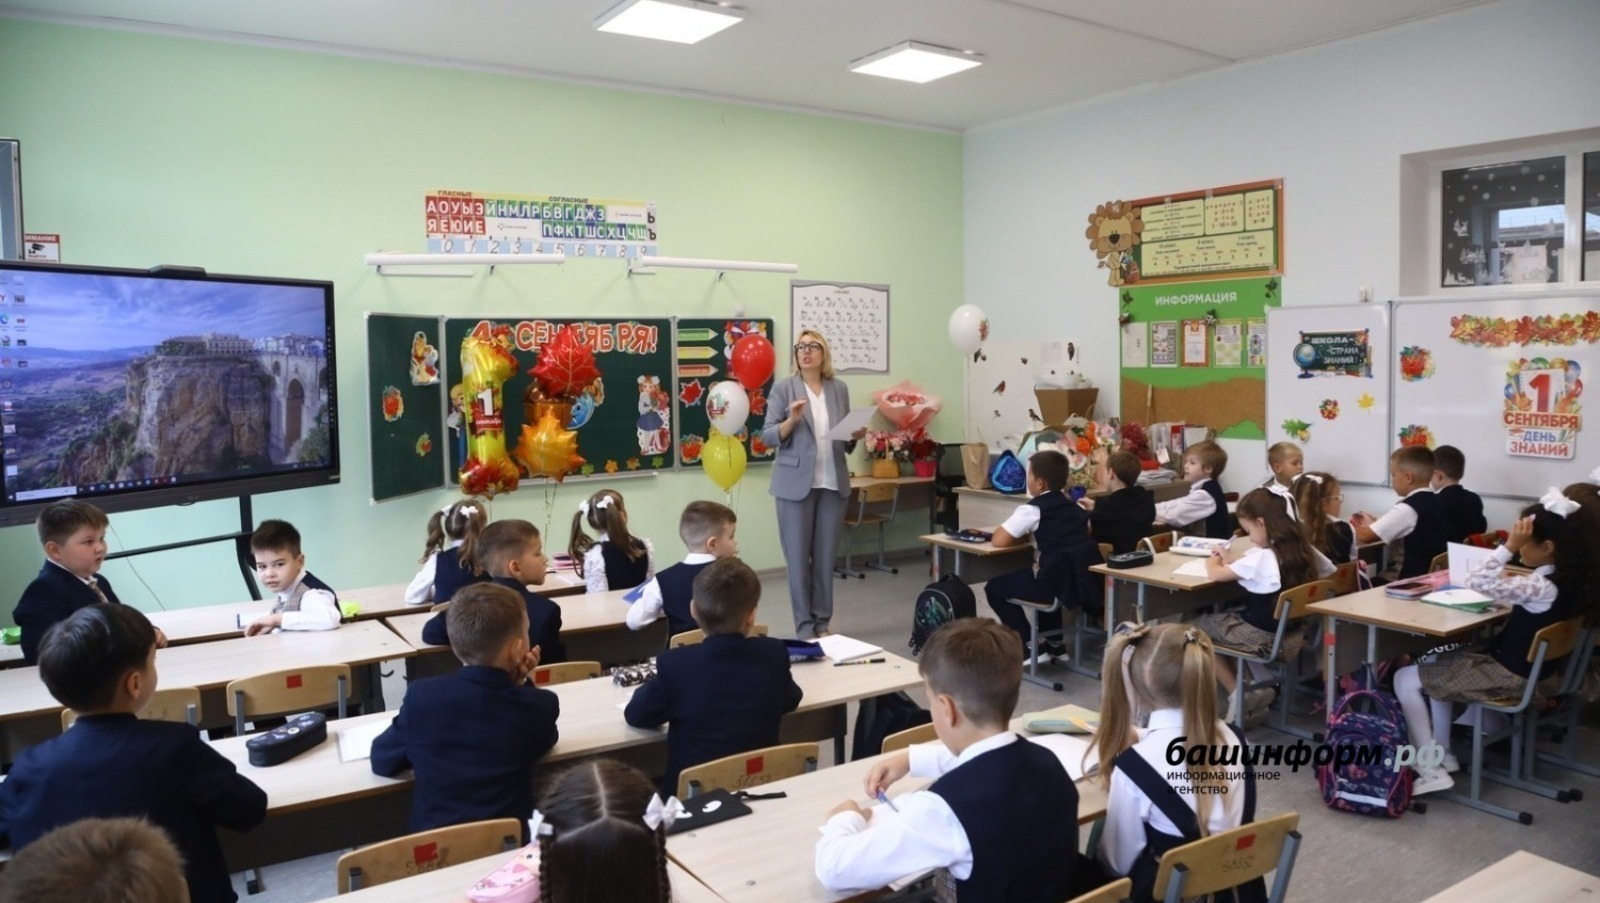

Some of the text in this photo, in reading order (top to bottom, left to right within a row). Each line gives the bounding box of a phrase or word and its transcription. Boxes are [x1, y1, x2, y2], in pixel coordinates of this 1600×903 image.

[548, 196, 588, 204] СОГЛАСНЫЕ
[444, 239, 454, 253] 0
[490, 240, 500, 254] 2
[512, 241, 522, 254] 3
[577, 243, 585, 256] 6
[619, 245, 627, 258] 8
[1155, 291, 1238, 306] ИНФОРМАЦИЯ
[1527, 373, 1551, 413] 1
[477, 388, 494, 416] 1
[1503, 412, 1579, 429] СЕНТЯБРЯ
[1522, 430, 1557, 443] ДЕНЬ
[1510, 441, 1569, 456] ЗНАНИЙ
